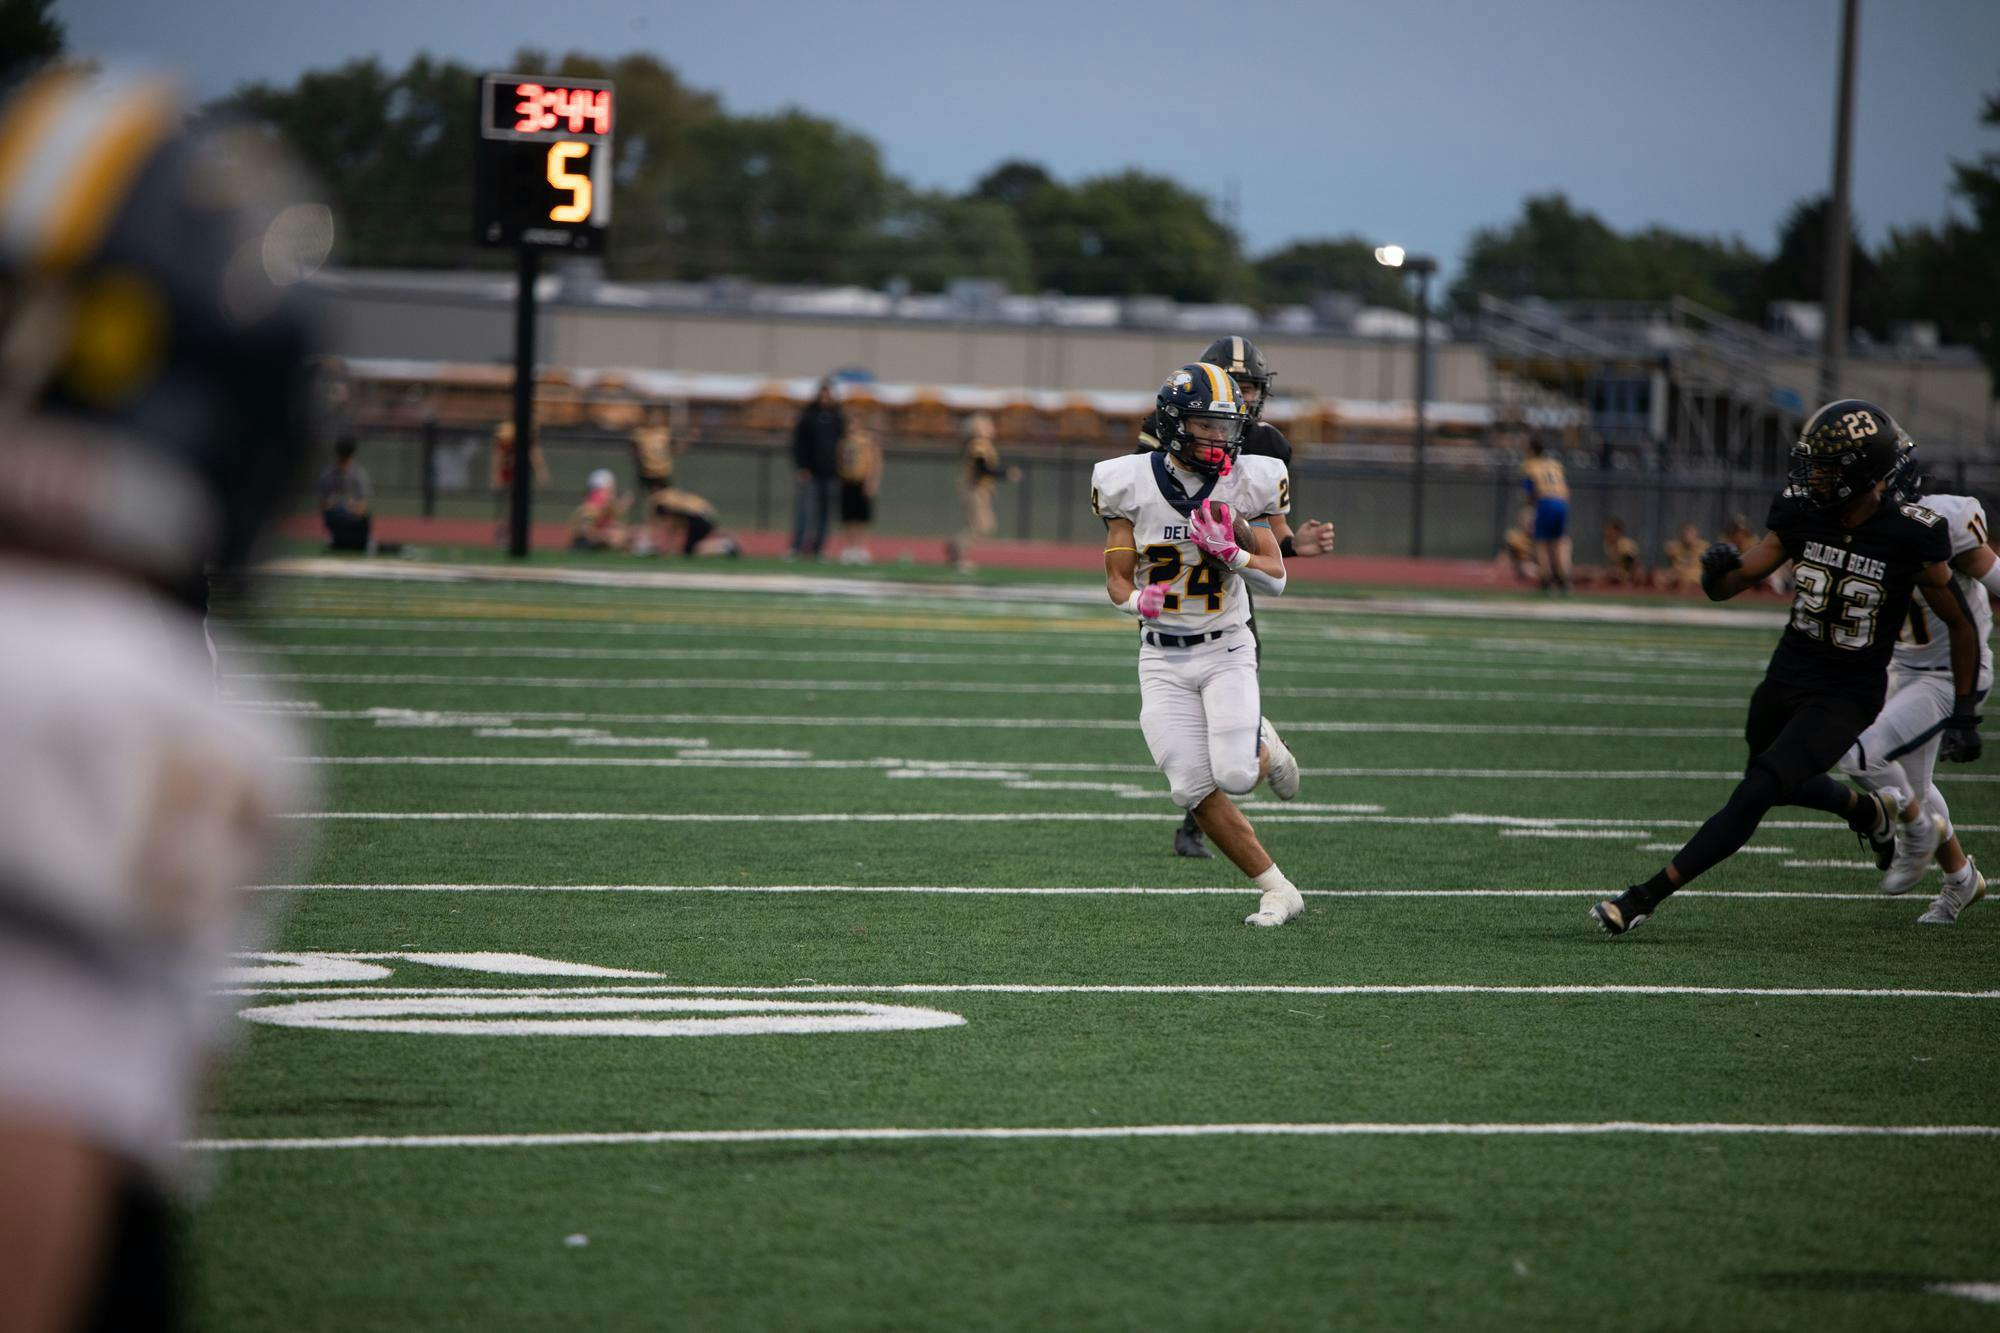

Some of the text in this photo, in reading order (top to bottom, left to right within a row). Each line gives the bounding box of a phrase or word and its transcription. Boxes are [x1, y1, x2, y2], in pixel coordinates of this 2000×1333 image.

[515, 83, 612, 135] 3:44
[547, 141, 593, 222] 5
[1842, 411, 1878, 440] 23
[1163, 526, 1191, 539] DEL
[1143, 544, 1223, 612] 24
[1803, 541, 1886, 580] GOLDEN BEARS
[1792, 561, 1887, 650] 23
